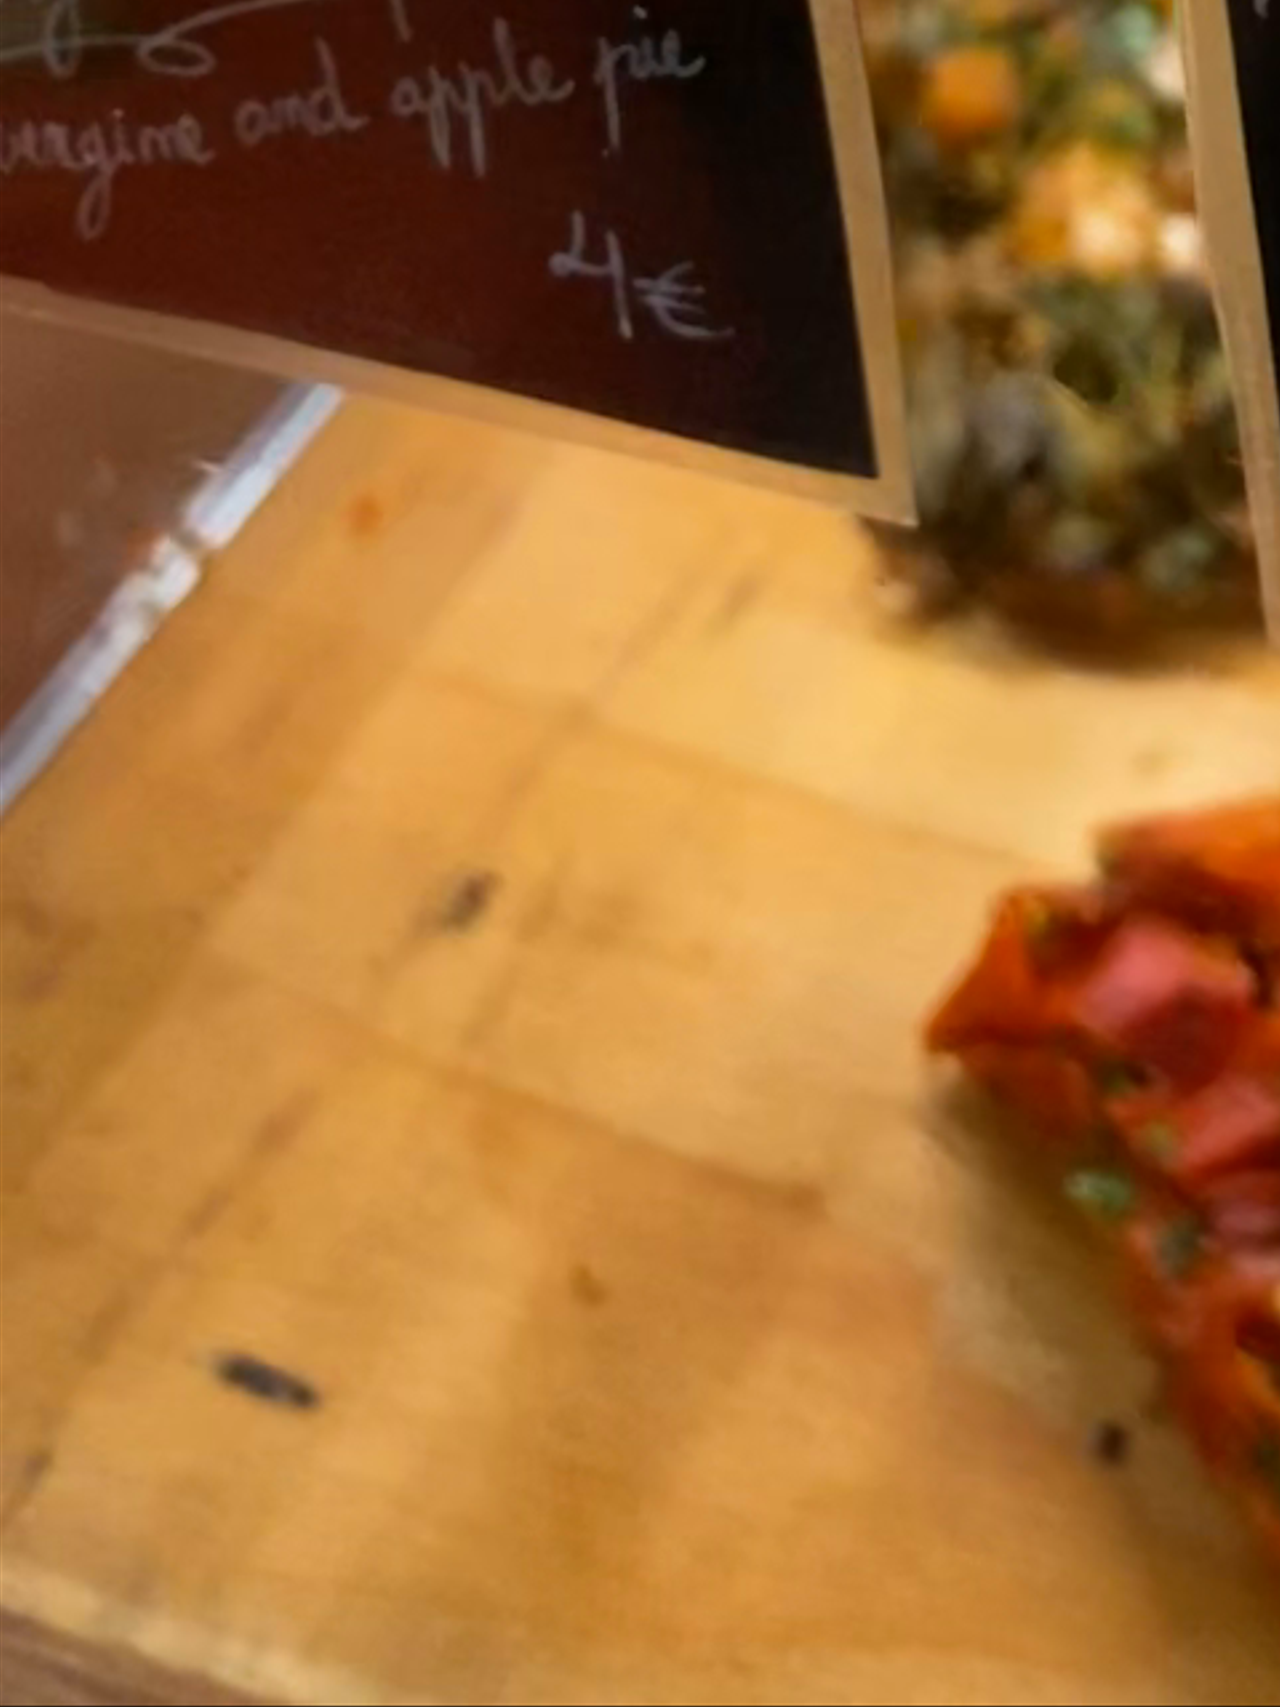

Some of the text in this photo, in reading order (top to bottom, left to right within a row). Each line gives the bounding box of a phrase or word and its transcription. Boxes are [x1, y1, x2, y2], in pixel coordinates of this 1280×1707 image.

[234, 37, 370, 145] and
[390, 17, 576, 177] apple
[590, 5, 708, 161] pie
[548, 209, 736, 341] 4€
